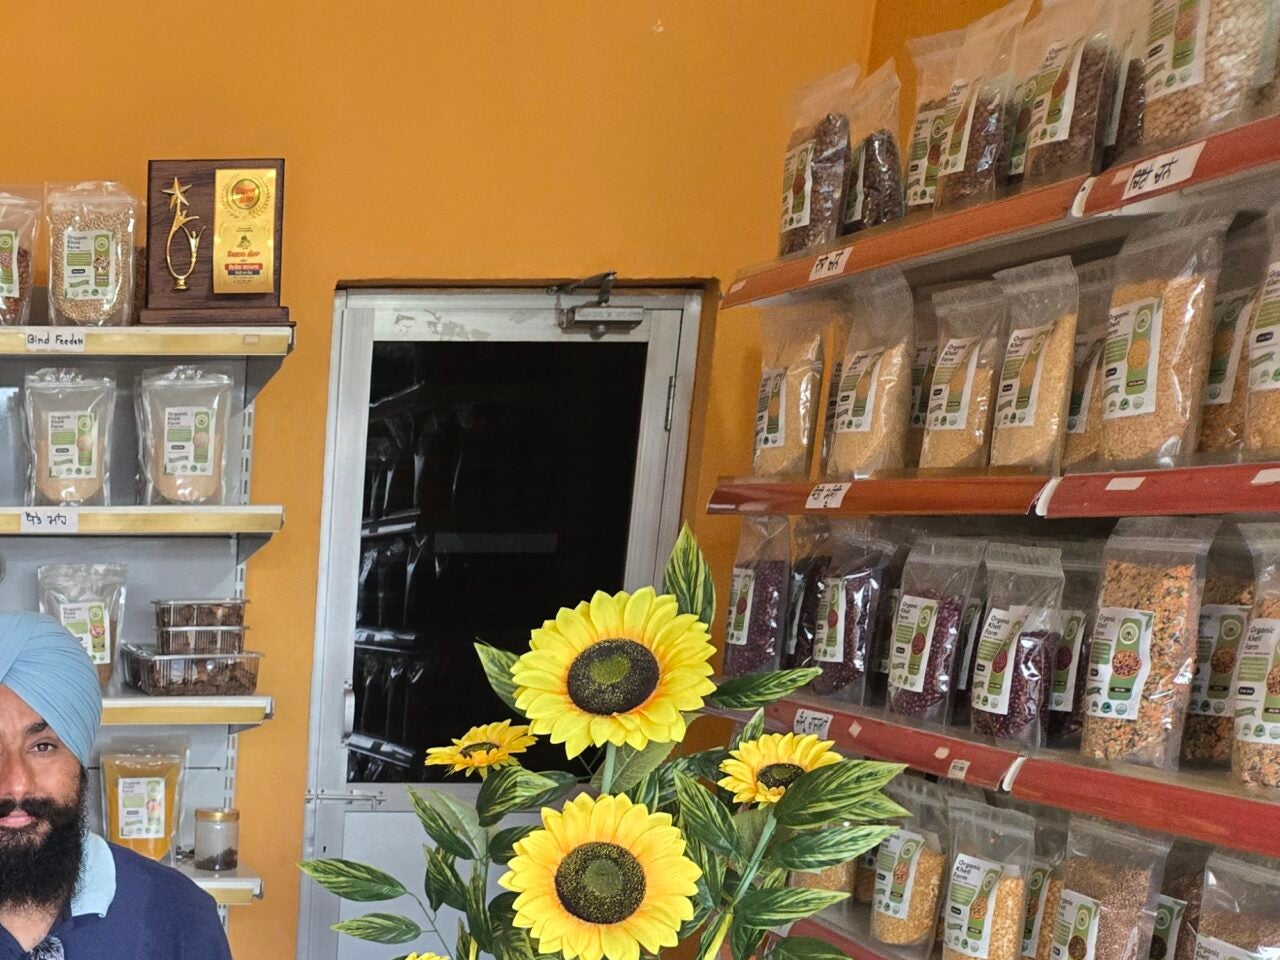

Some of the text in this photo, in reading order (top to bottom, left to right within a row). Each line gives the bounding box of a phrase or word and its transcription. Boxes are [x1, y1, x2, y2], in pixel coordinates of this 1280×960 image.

[958, 860, 981, 871] Organic
[956, 866, 970, 875] Kheti
[953, 872, 969, 881] Farm
